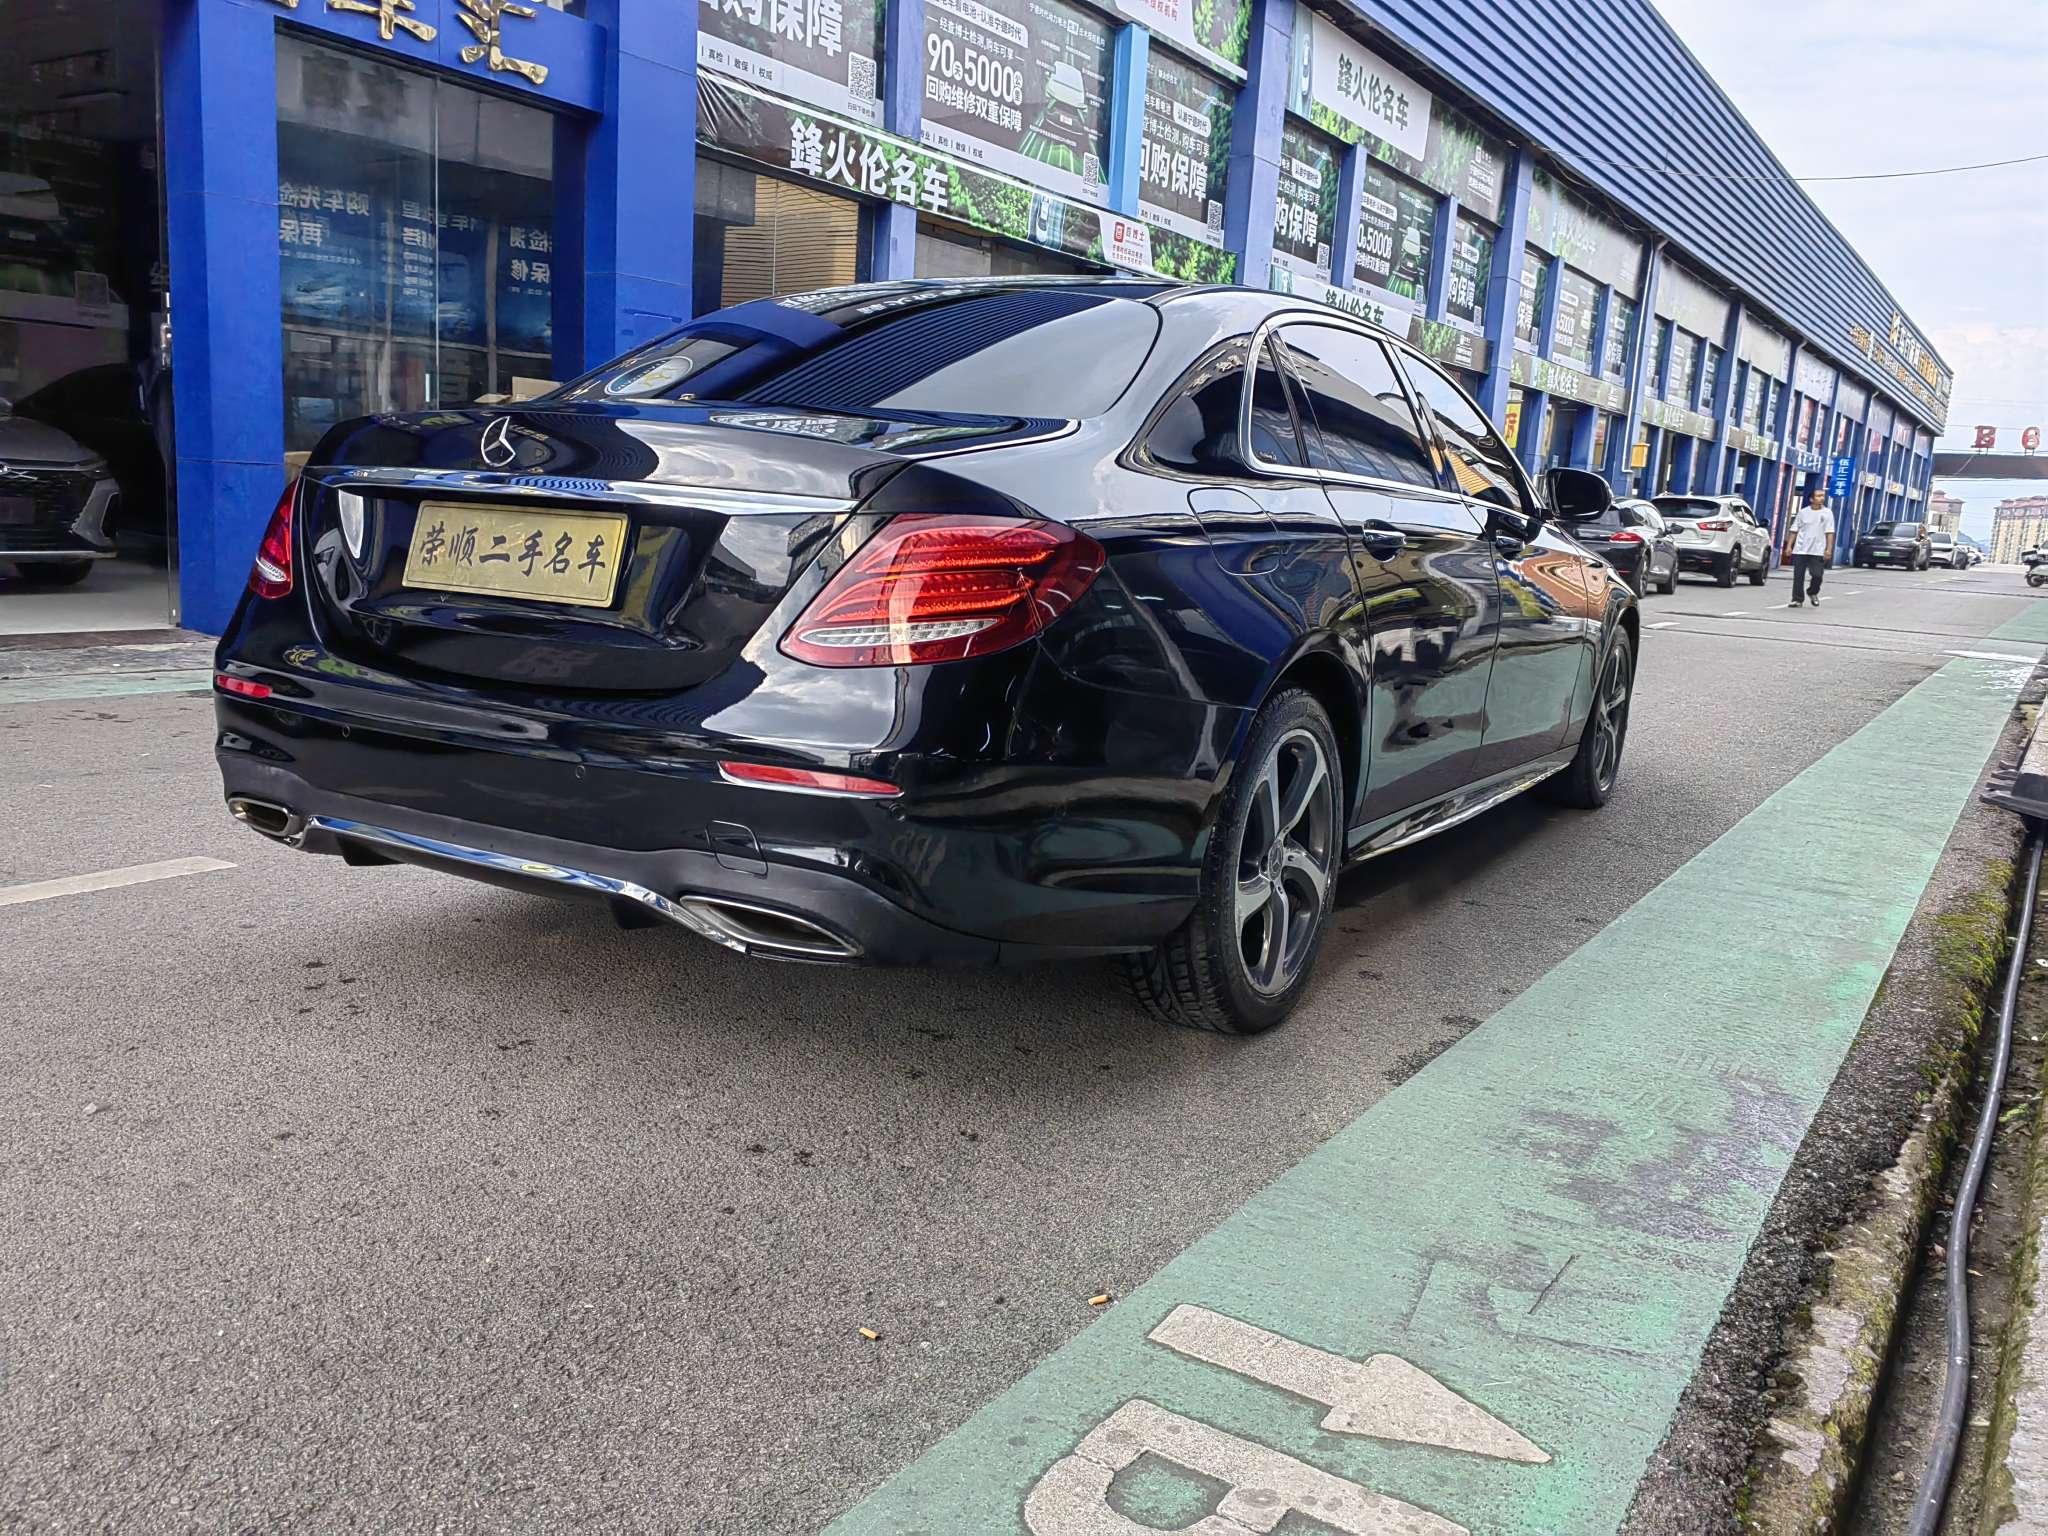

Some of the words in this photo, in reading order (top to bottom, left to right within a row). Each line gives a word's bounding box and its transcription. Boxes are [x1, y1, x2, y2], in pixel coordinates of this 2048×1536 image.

[924, 73, 1023, 133] 回购维修双重保障
[1336, 52, 1409, 131] 鋒火伦名车
[790, 117, 949, 212] 鋒火伦名车
[419, 521, 606, 584] 荣顺二手名车
